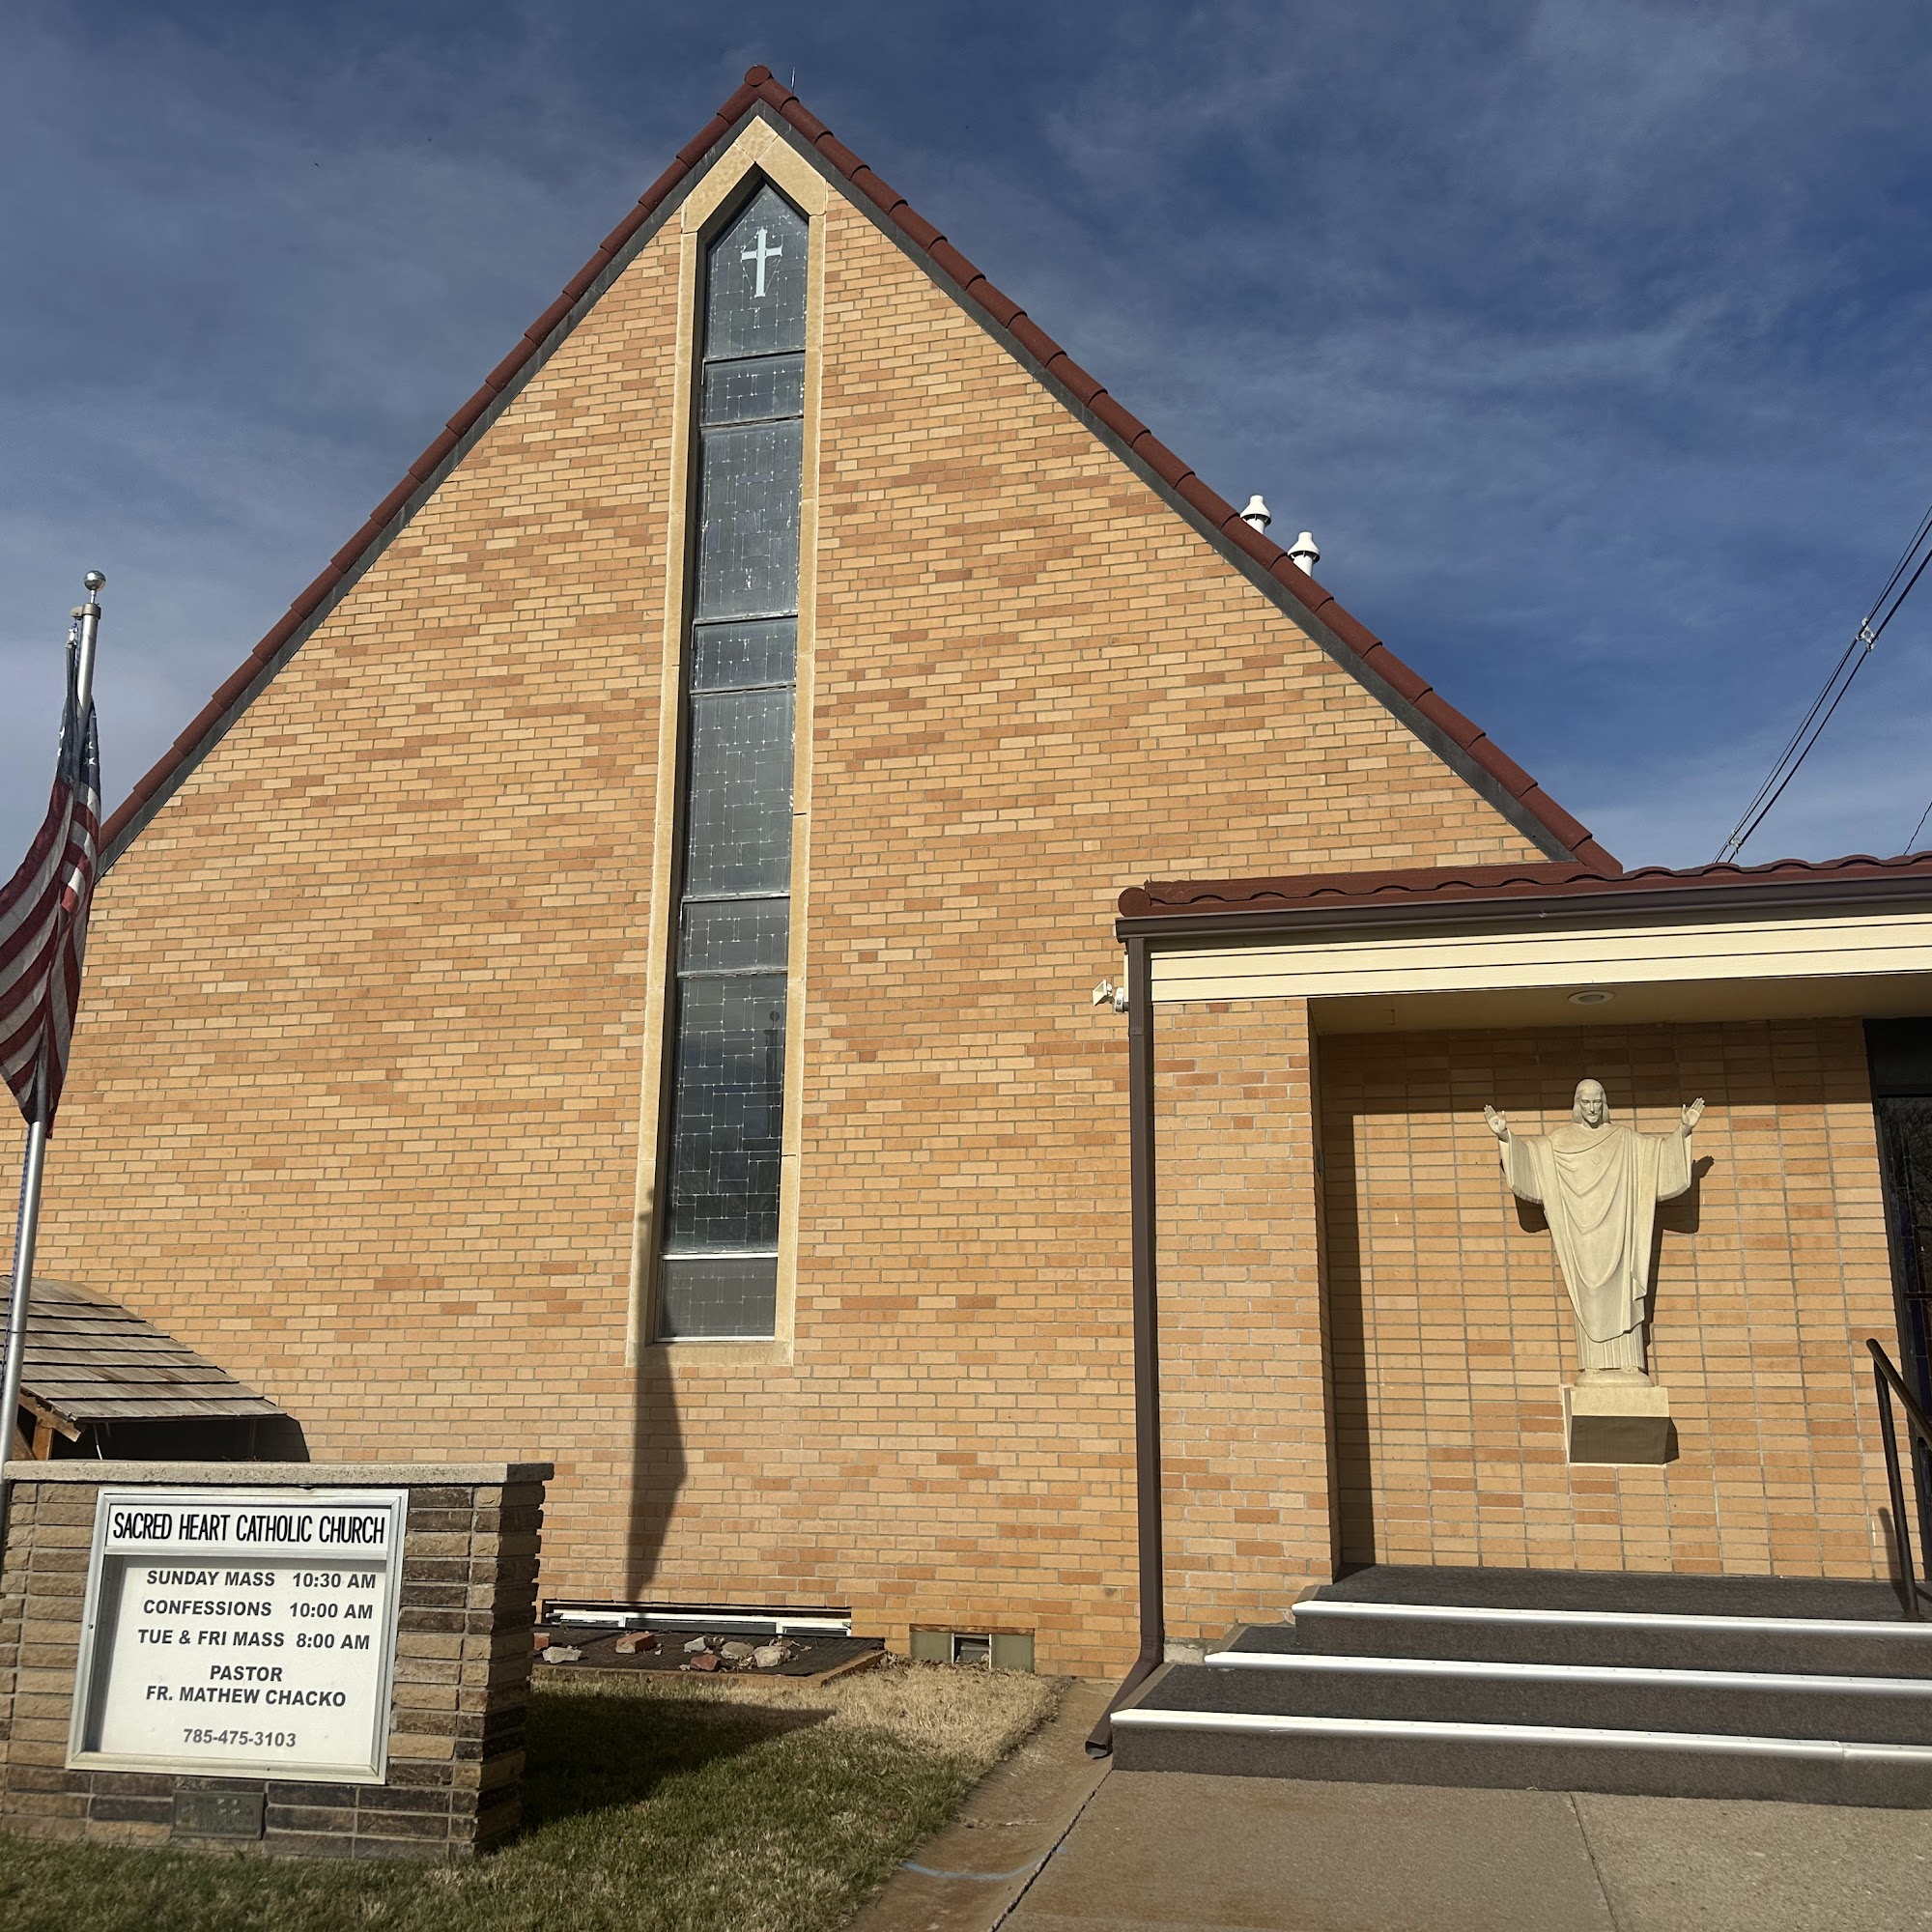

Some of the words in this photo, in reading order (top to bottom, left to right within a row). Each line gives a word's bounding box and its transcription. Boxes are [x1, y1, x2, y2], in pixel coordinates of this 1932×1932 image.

[113, 1513, 172, 1539] SACRED
[179, 1515, 230, 1540] HEART
[237, 1515, 312, 1542] CATHOLIC
[320, 1516, 384, 1543] CHURCH
[146, 1571, 219, 1585] SUNDAY
[224, 1571, 275, 1586] MASS
[293, 1572, 341, 1587] 10:30
[347, 1574, 376, 1588] AM
[143, 1600, 271, 1616] CONFESSIONS
[290, 1603, 338, 1617] 10:00
[343, 1605, 373, 1618] AM
[138, 1630, 174, 1643] TUE
[179, 1631, 191, 1644] &
[197, 1632, 227, 1645] FRI
[232, 1632, 285, 1646] MASS
[296, 1634, 335, 1648] 8:00
[340, 1635, 370, 1649] AM
[210, 1665, 283, 1681] PASTOR
[146, 1686, 173, 1700] FR.
[179, 1688, 261, 1703] MATHEW
[265, 1690, 346, 1706] CHACKO
[184, 1729, 296, 1747] 785-475-3103
